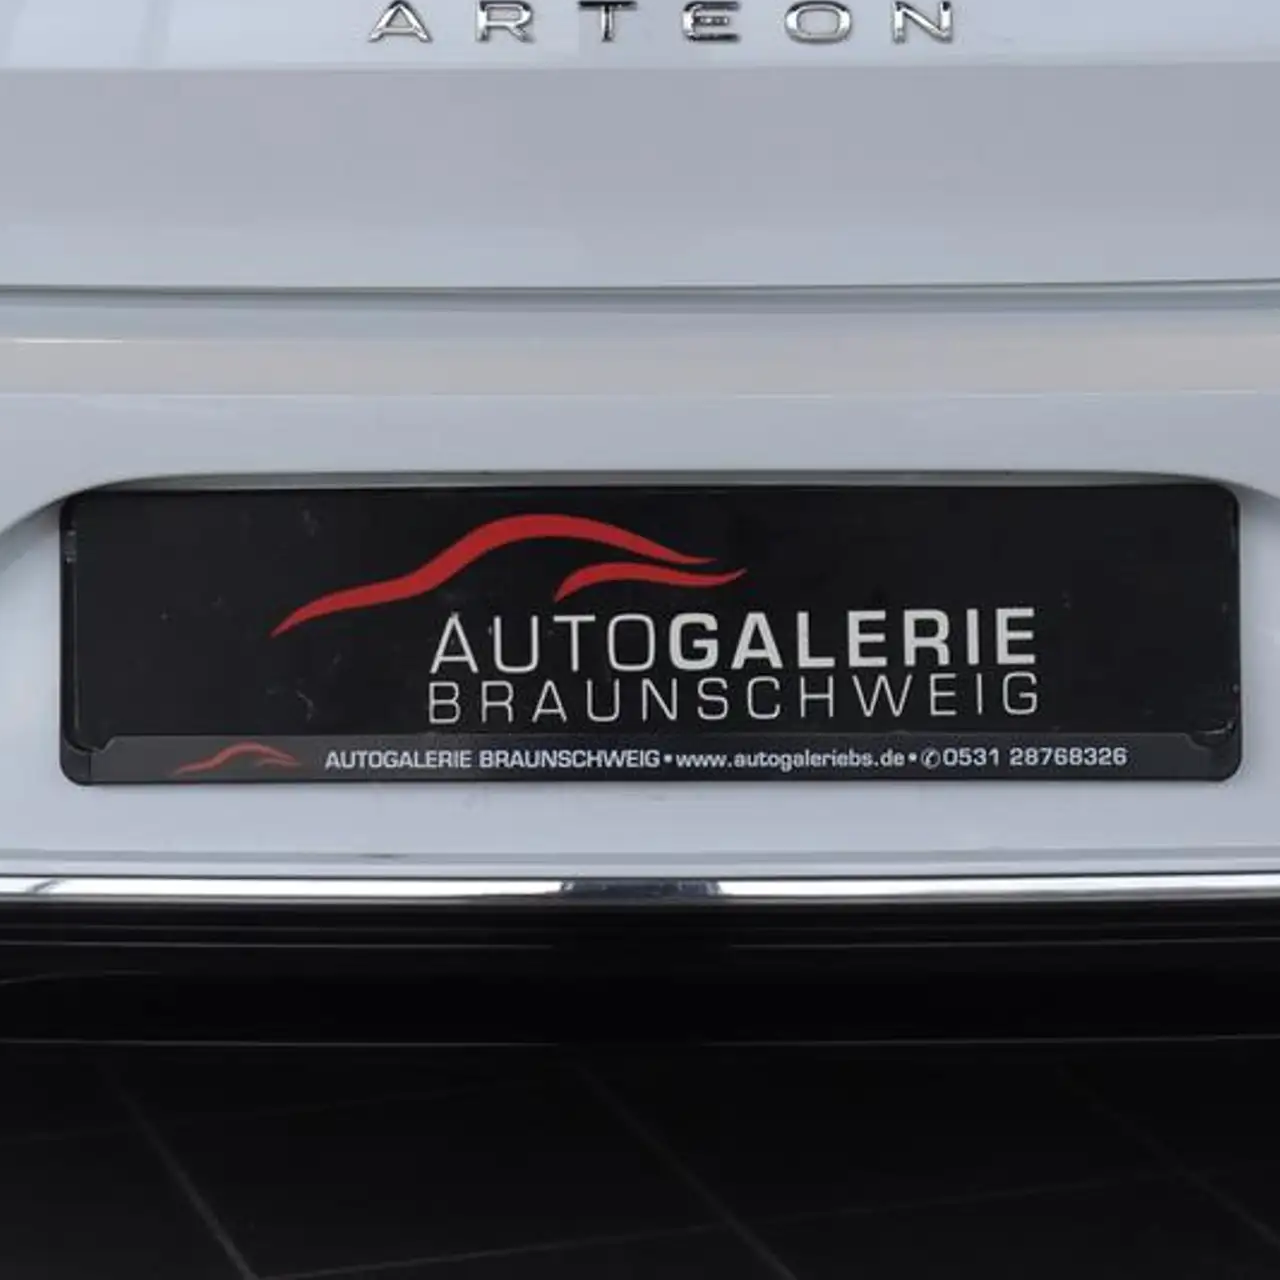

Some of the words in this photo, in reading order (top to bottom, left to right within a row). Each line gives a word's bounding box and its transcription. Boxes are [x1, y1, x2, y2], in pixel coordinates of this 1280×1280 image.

[429, 607, 1037, 674] AUTOGALERIE
[428, 671, 1039, 724] BRAUNSCHWEIG
[325, 749, 472, 770] AUTOGALERIE
[479, 749, 661, 769] BRAUNSCHWEIG
[675, 749, 905, 772] www.autogaleriebs.de
[942, 747, 1001, 767] 0531
[1009, 746, 1129, 766] 28768326
